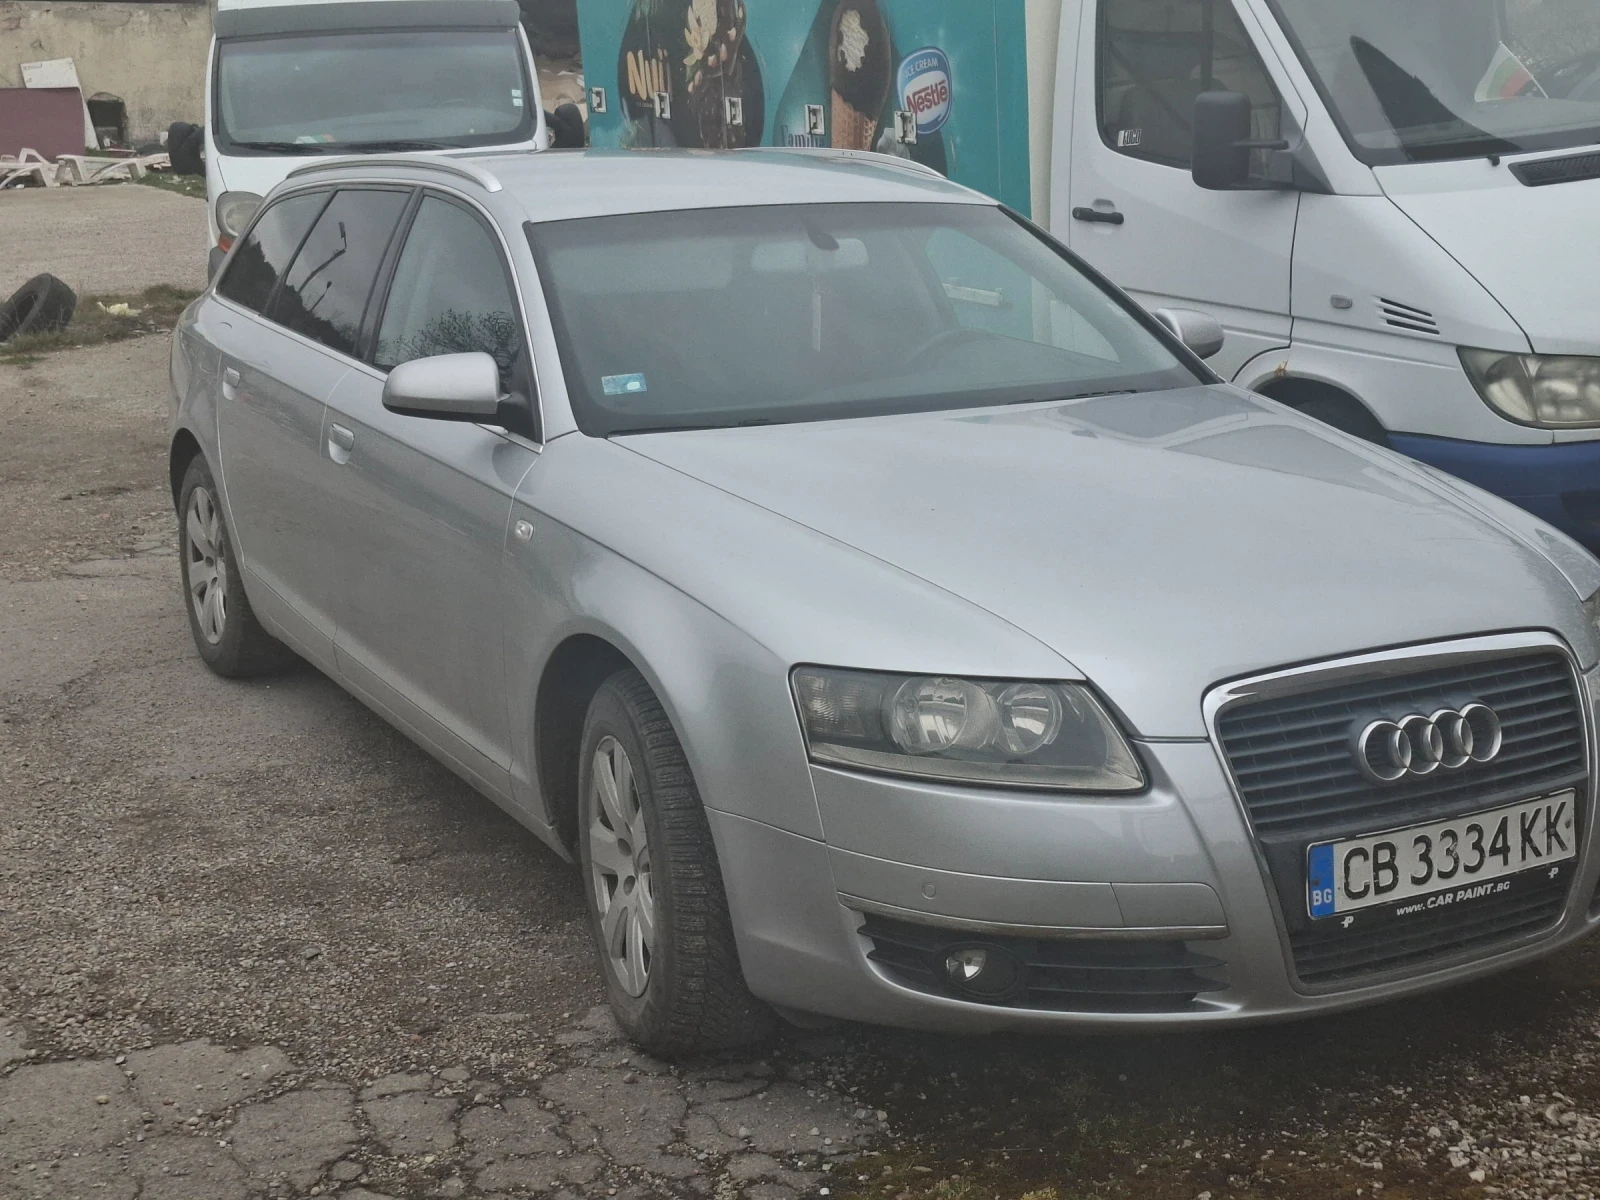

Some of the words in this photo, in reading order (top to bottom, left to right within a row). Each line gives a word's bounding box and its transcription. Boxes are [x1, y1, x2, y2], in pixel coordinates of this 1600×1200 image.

[905, 65, 915, 78] ICE
[915, 58, 938, 71] CREAM
[906, 79, 948, 114] Nestlé
[1312, 888, 1332, 906] BG
[1426, 893, 1453, 908] CAR
